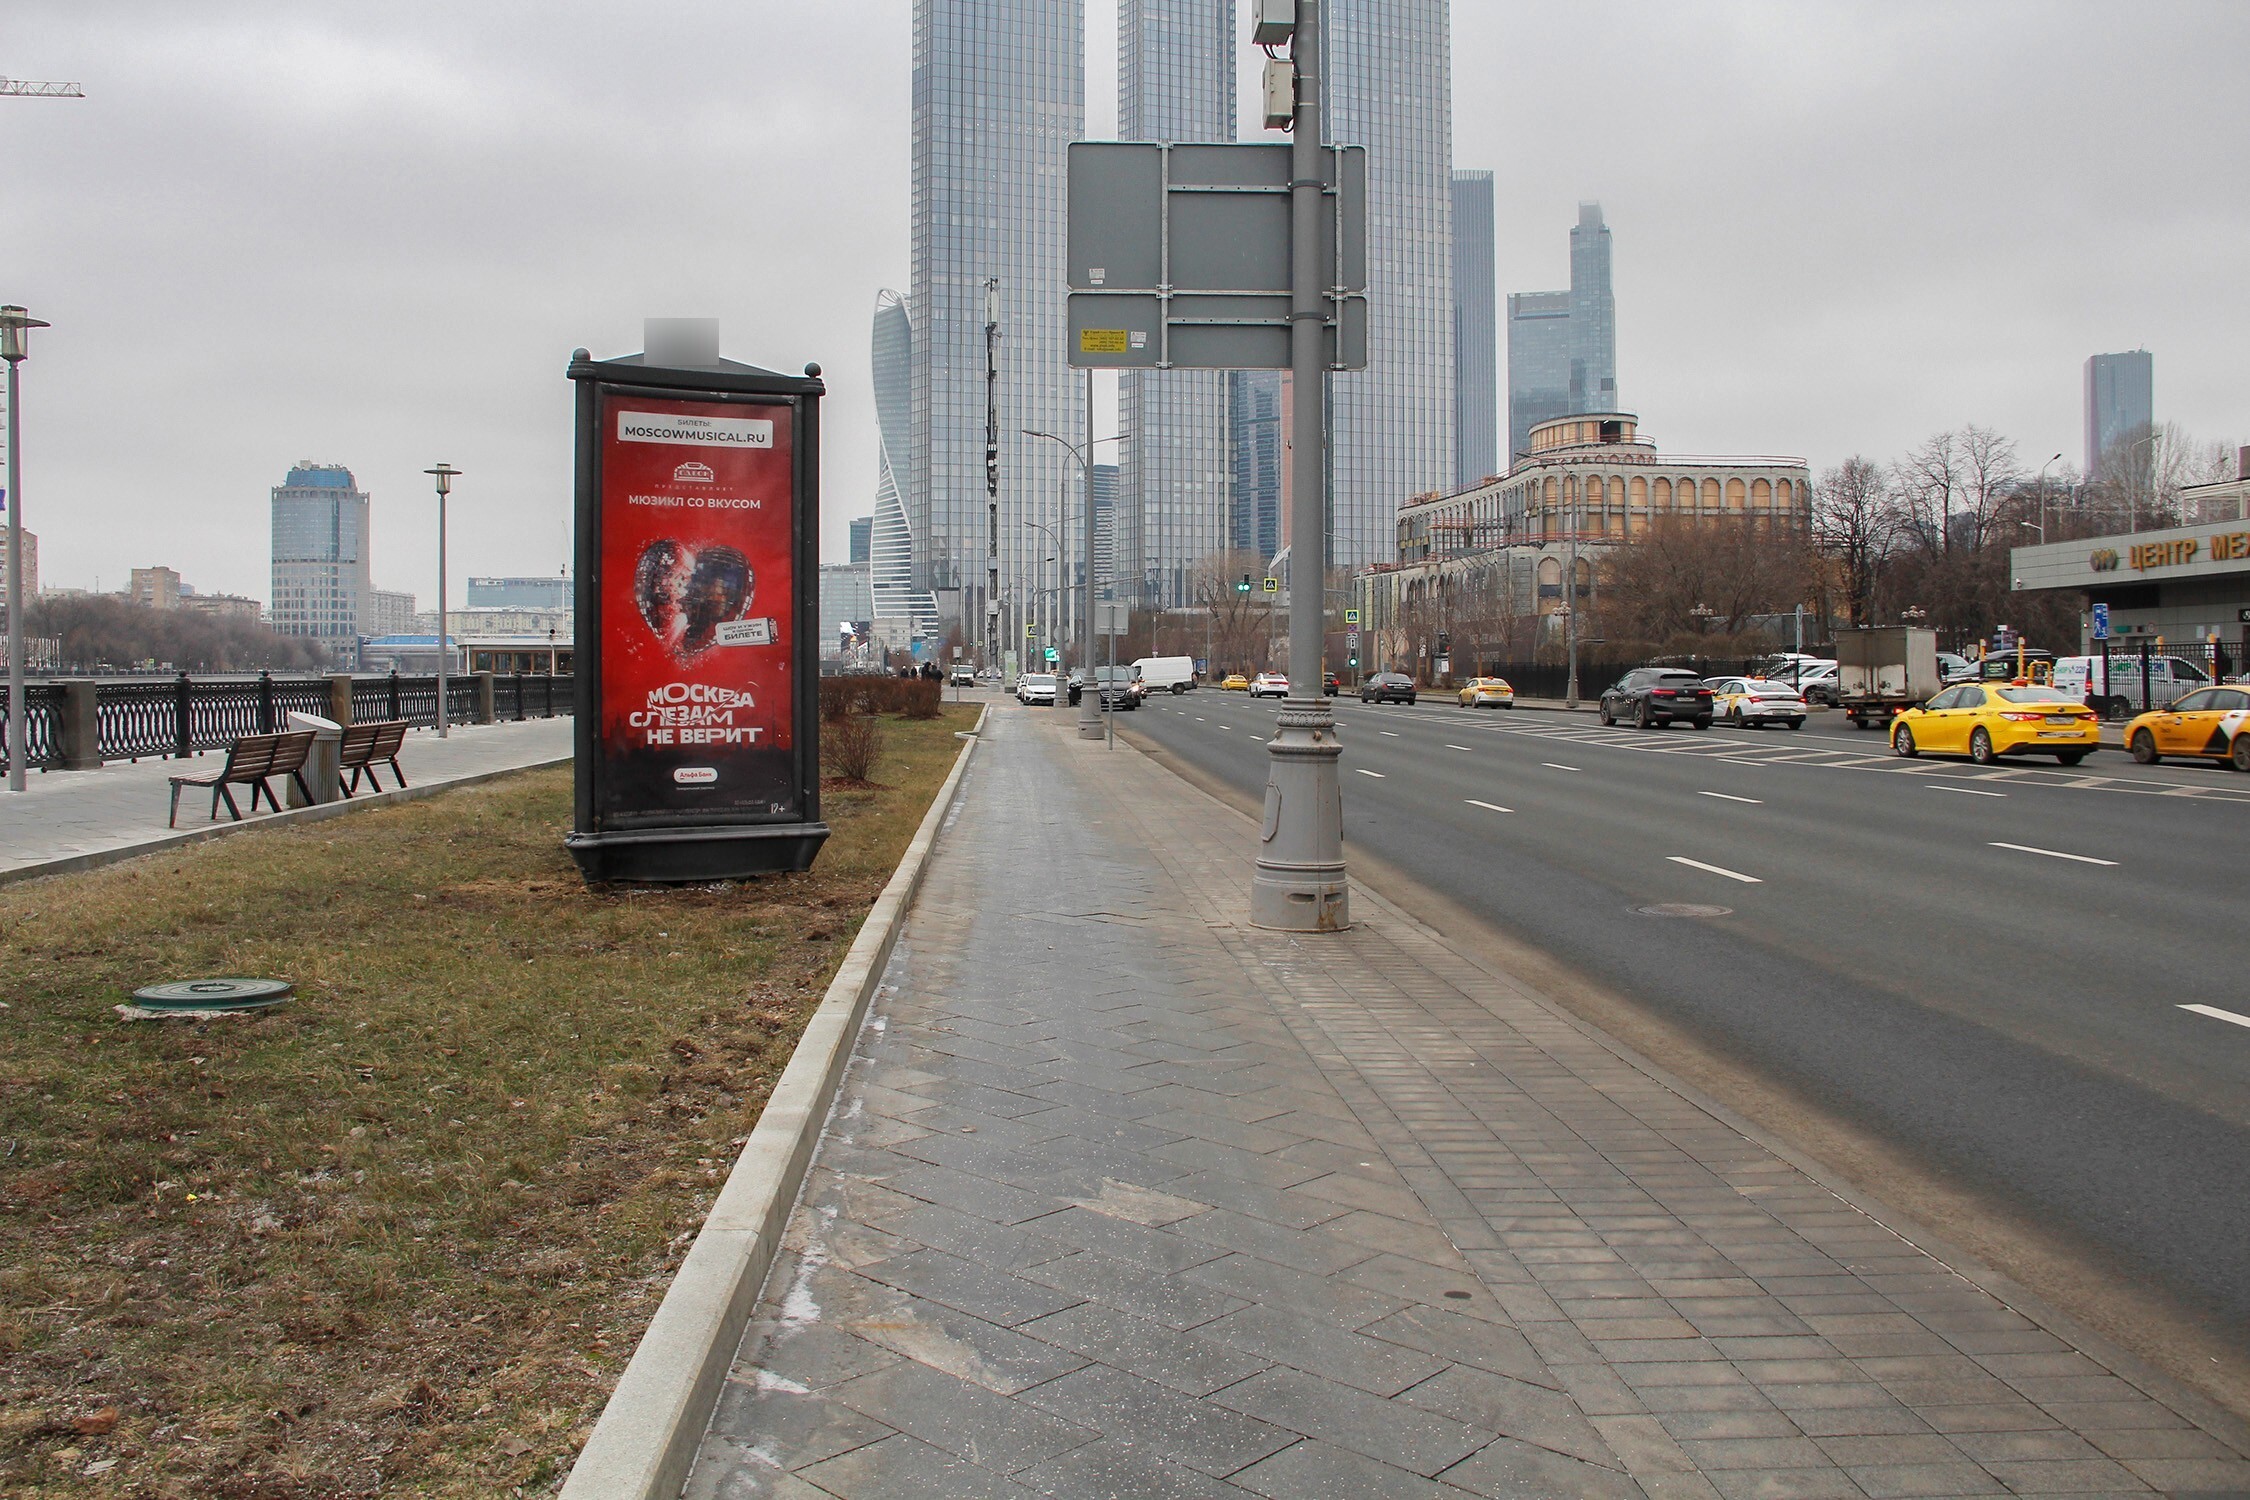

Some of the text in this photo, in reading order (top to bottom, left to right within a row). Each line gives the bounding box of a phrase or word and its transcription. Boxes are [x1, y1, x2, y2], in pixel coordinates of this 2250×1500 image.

[677, 419, 712, 428] БИЛЕТЫ:
[625, 426, 766, 443] MOSCOWMUSICAL.RU
[628, 494, 761, 509] МЮЗИКЛ СО ВКУСОМ
[2129, 538, 2198, 573] ЦЕНТР
[724, 630, 763, 641] БИЛЕТЕ
[646, 682, 756, 709] МОСКВА
[629, 705, 733, 728] СЛЕЗАМ
[647, 727, 764, 745] НЕ ВЕРИТ
[770, 802, 786, 814] 12+
